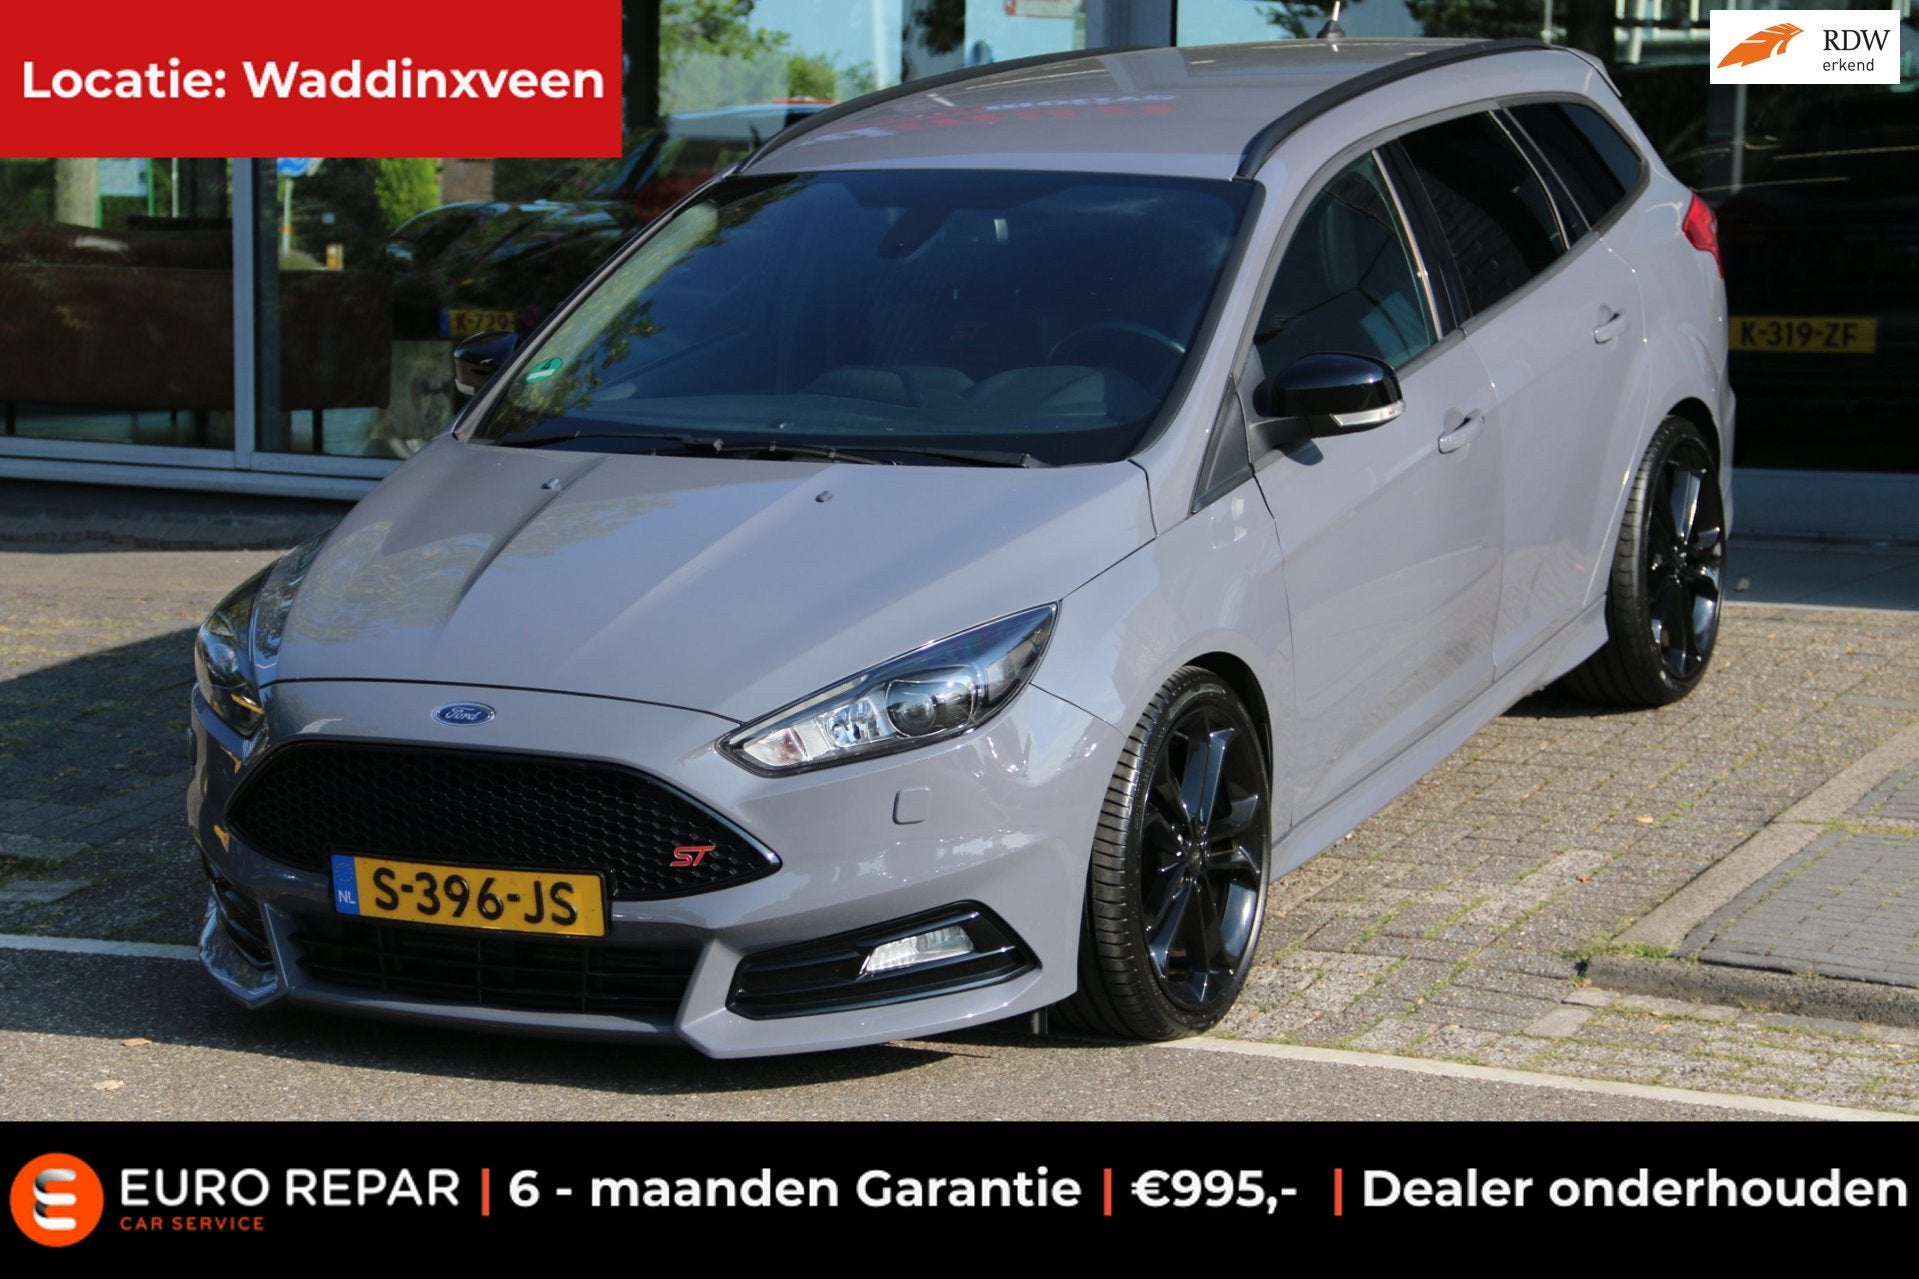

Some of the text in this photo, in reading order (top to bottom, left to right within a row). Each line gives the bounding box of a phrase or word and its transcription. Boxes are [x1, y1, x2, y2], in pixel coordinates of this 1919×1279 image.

[1741, 320, 1858, 348] K-319-ZF
[445, 706, 482, 721] Ford
[670, 845, 716, 867] ST
[338, 889, 356, 905] NL
[372, 866, 578, 927] S-396-JS
